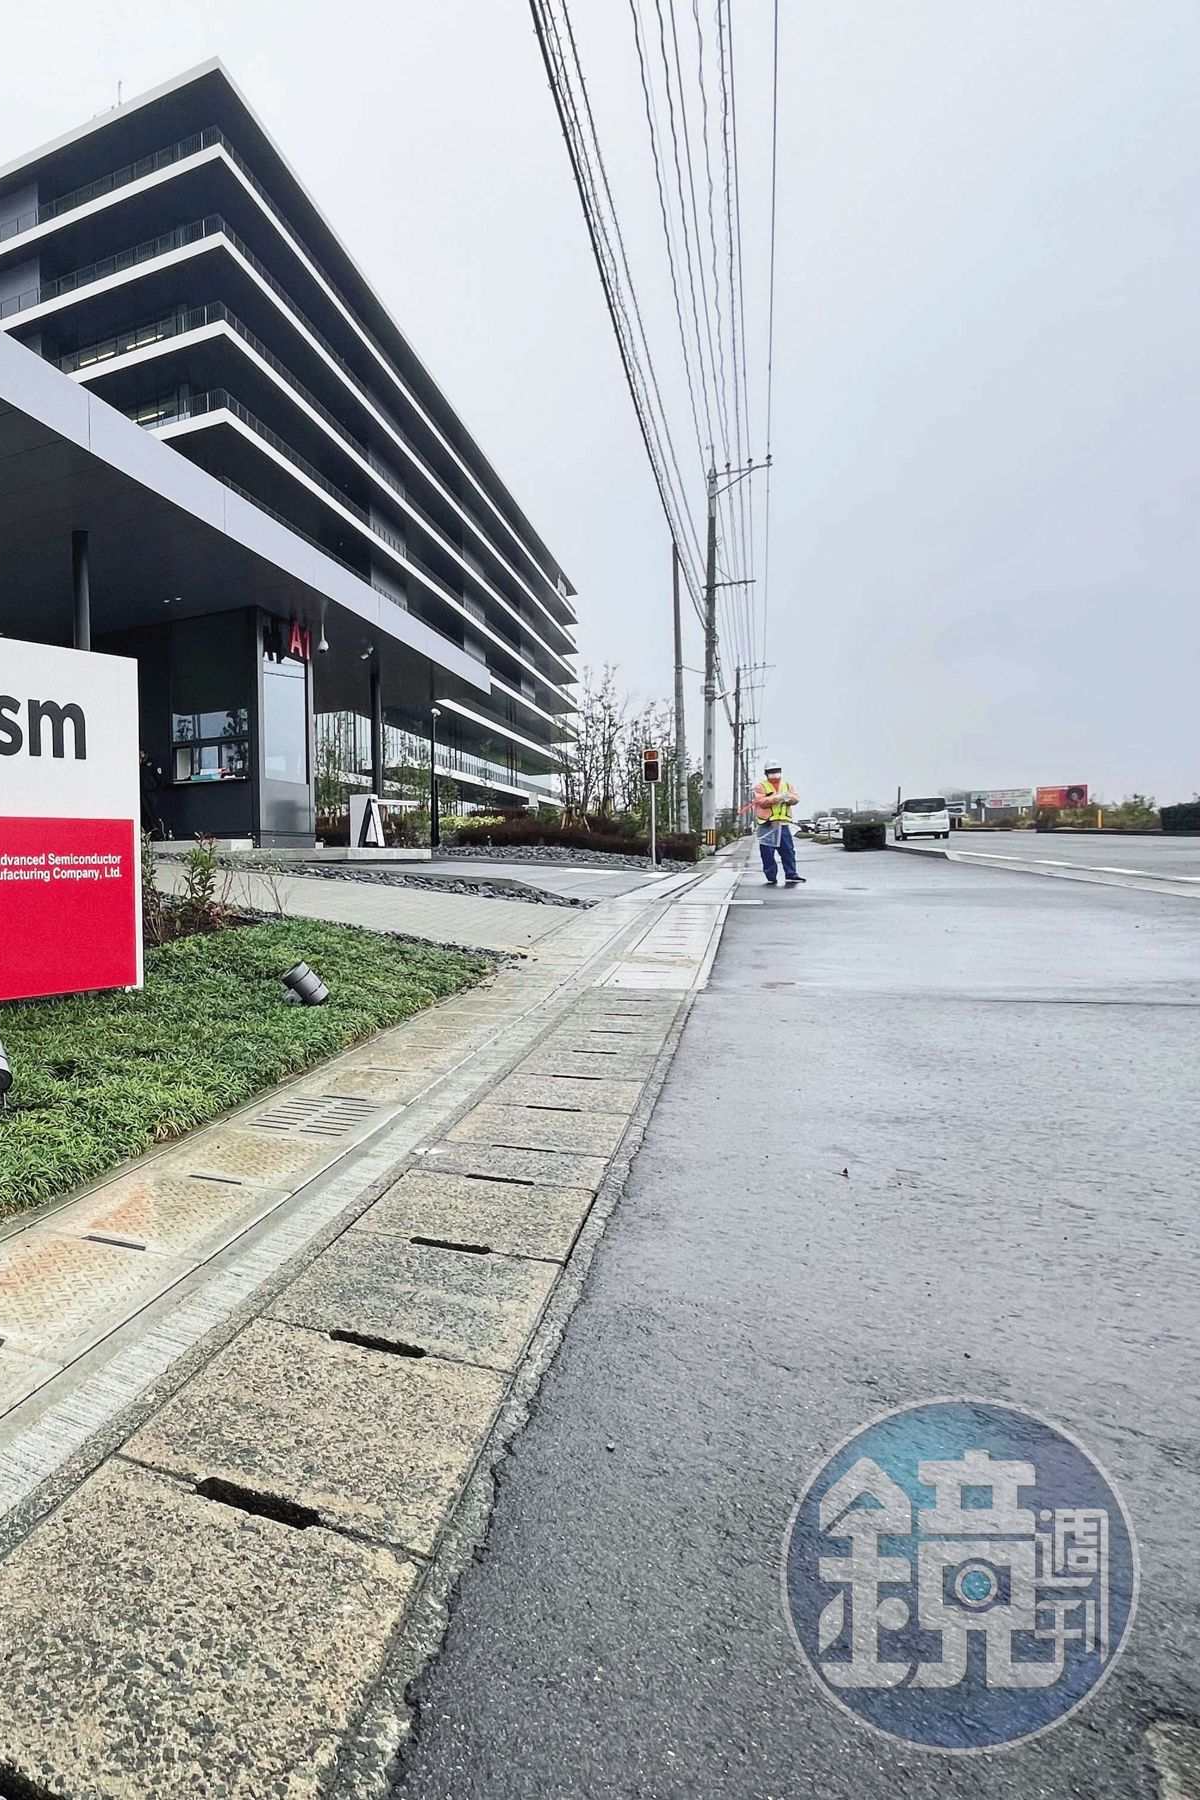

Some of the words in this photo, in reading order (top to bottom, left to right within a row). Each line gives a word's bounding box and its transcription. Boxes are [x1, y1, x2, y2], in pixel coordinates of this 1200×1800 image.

[48, 853, 122, 866] Semiconductor
[53, 867, 103, 882] Company,
[104, 866, 123, 878] Ltd.
